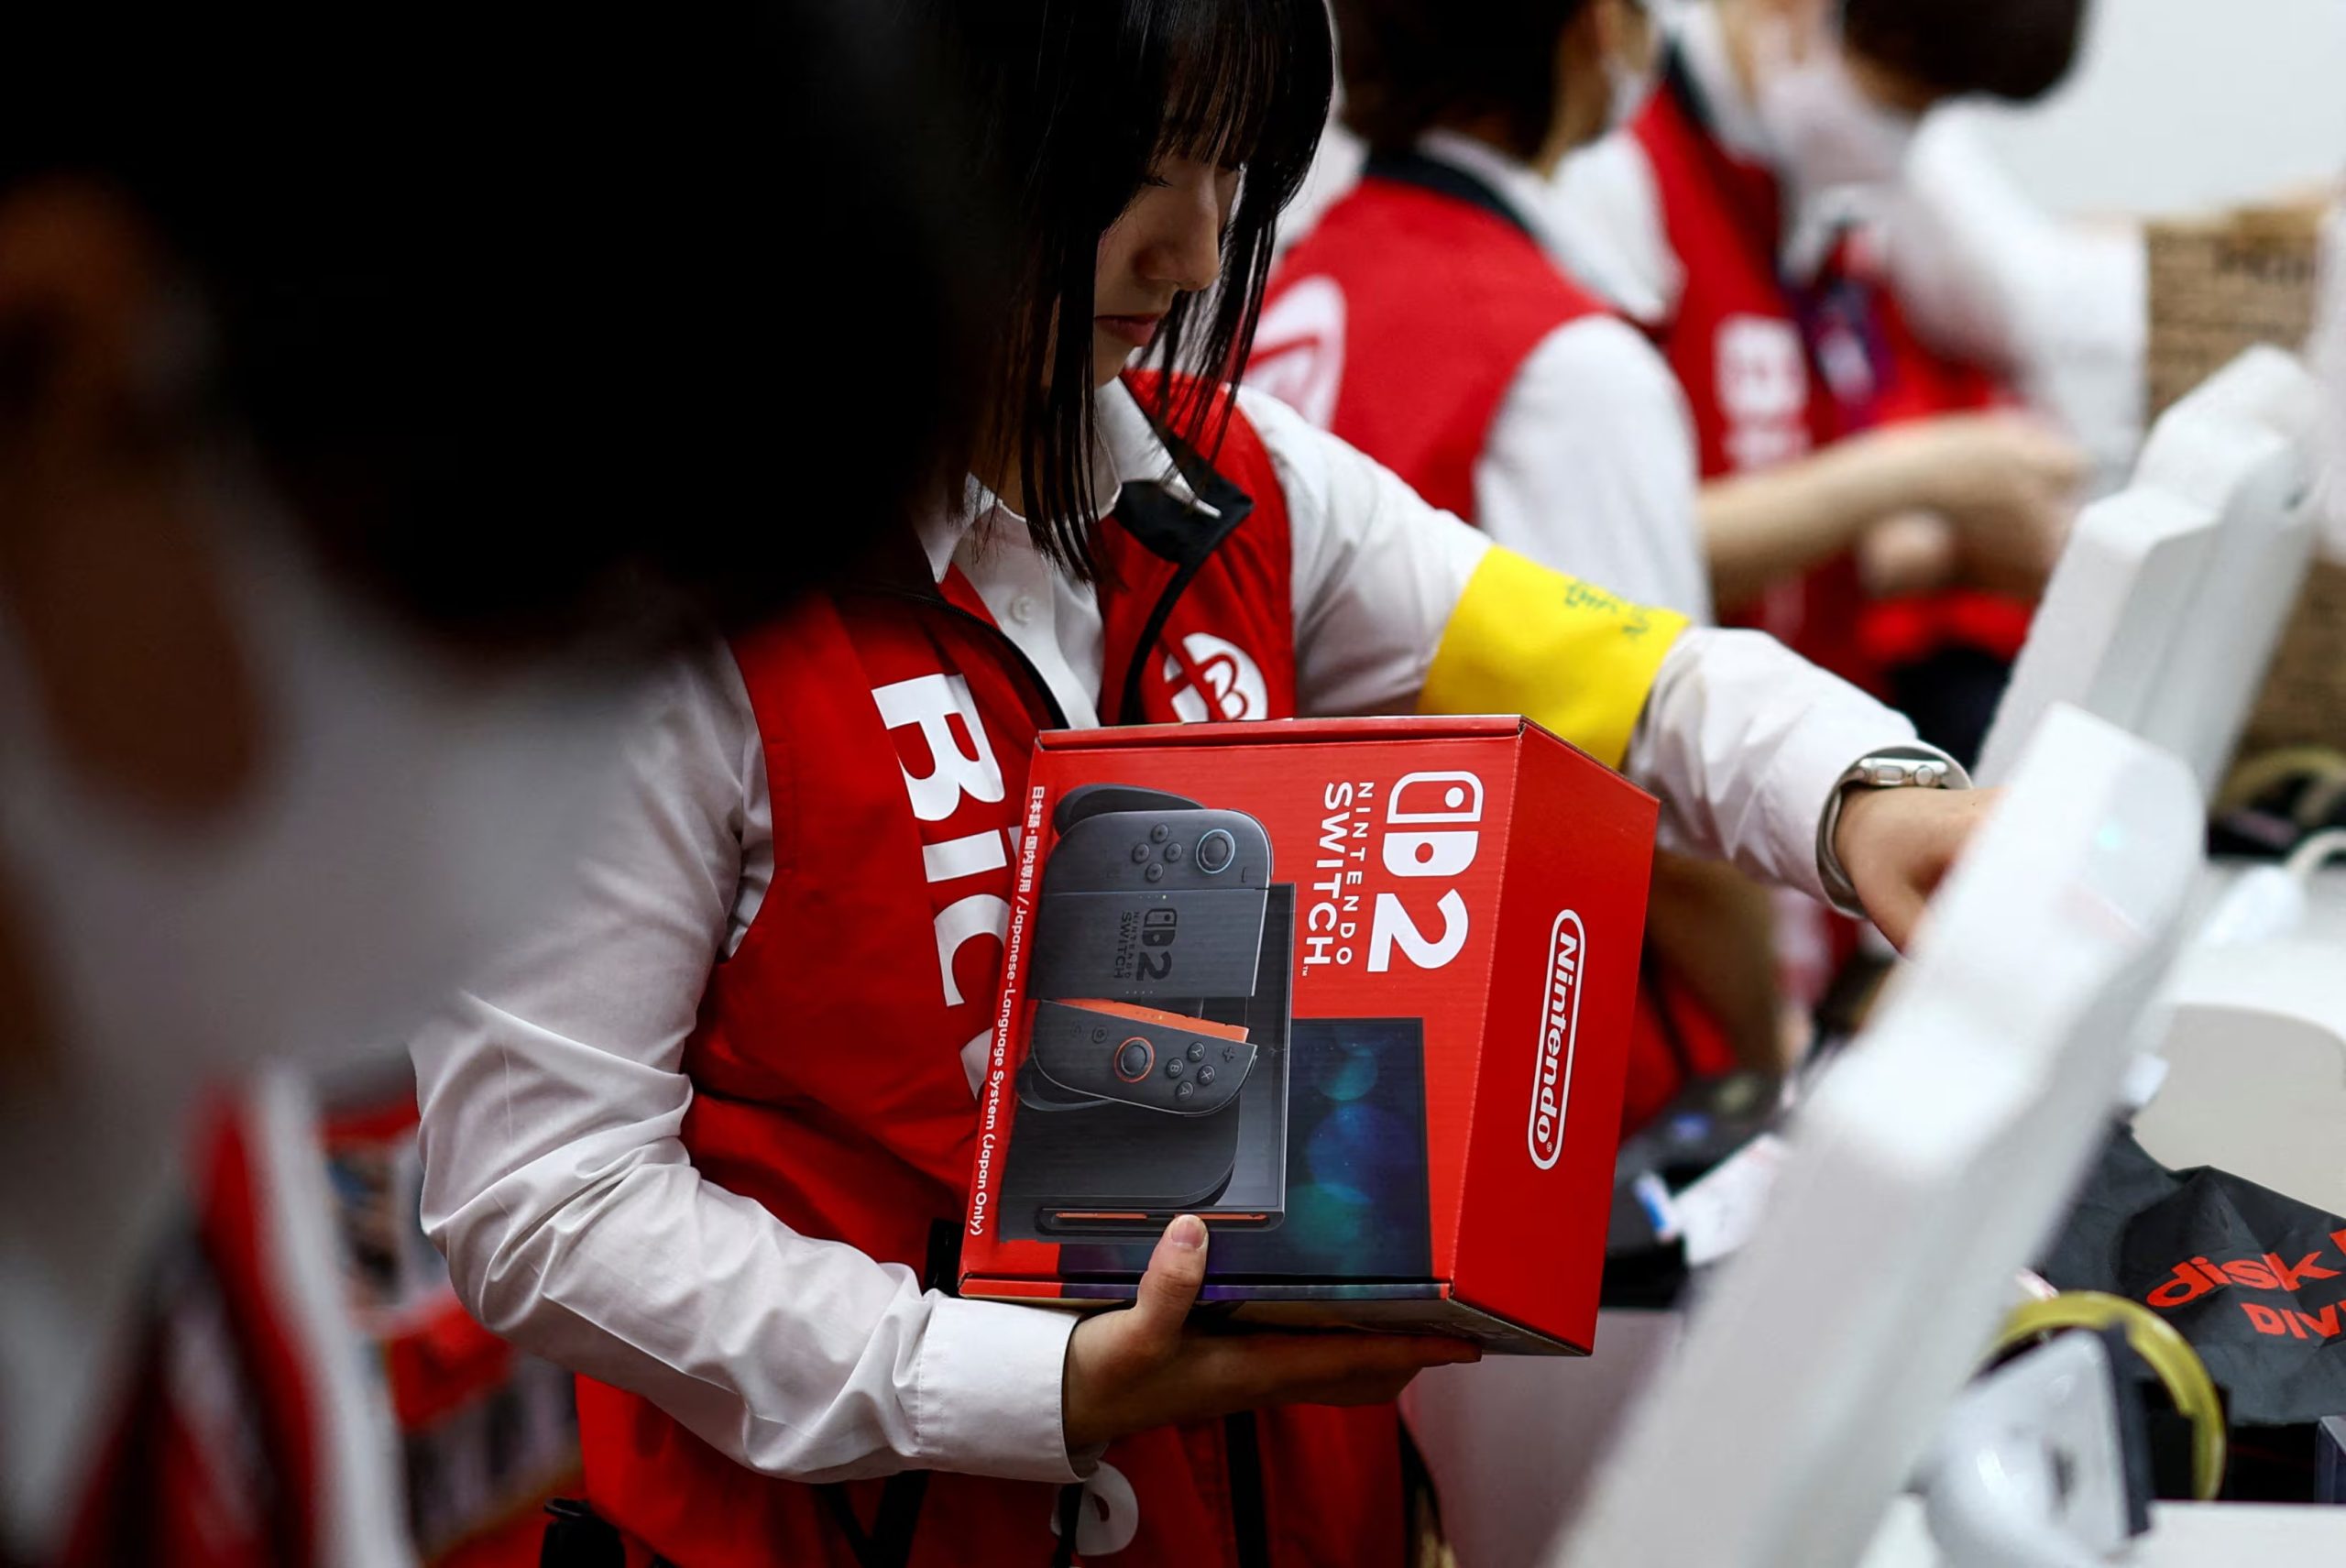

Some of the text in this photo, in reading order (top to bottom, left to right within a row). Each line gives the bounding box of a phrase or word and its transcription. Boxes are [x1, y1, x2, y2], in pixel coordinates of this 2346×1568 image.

[1335, 782, 1375, 965] NINTENDO
[1113, 911, 1133, 978] SWITCH
[1367, 888, 1469, 972] 2
[993, 905, 1027, 1067] Japanese-Language
[1136, 951, 1172, 981] 2
[986, 1070, 1004, 1130] System
[978, 1135, 996, 1190] (Japan
[970, 1191, 988, 1235] Only)
[2146, 1252, 2342, 1307] disk
[2240, 1299, 2346, 1339] DIV
